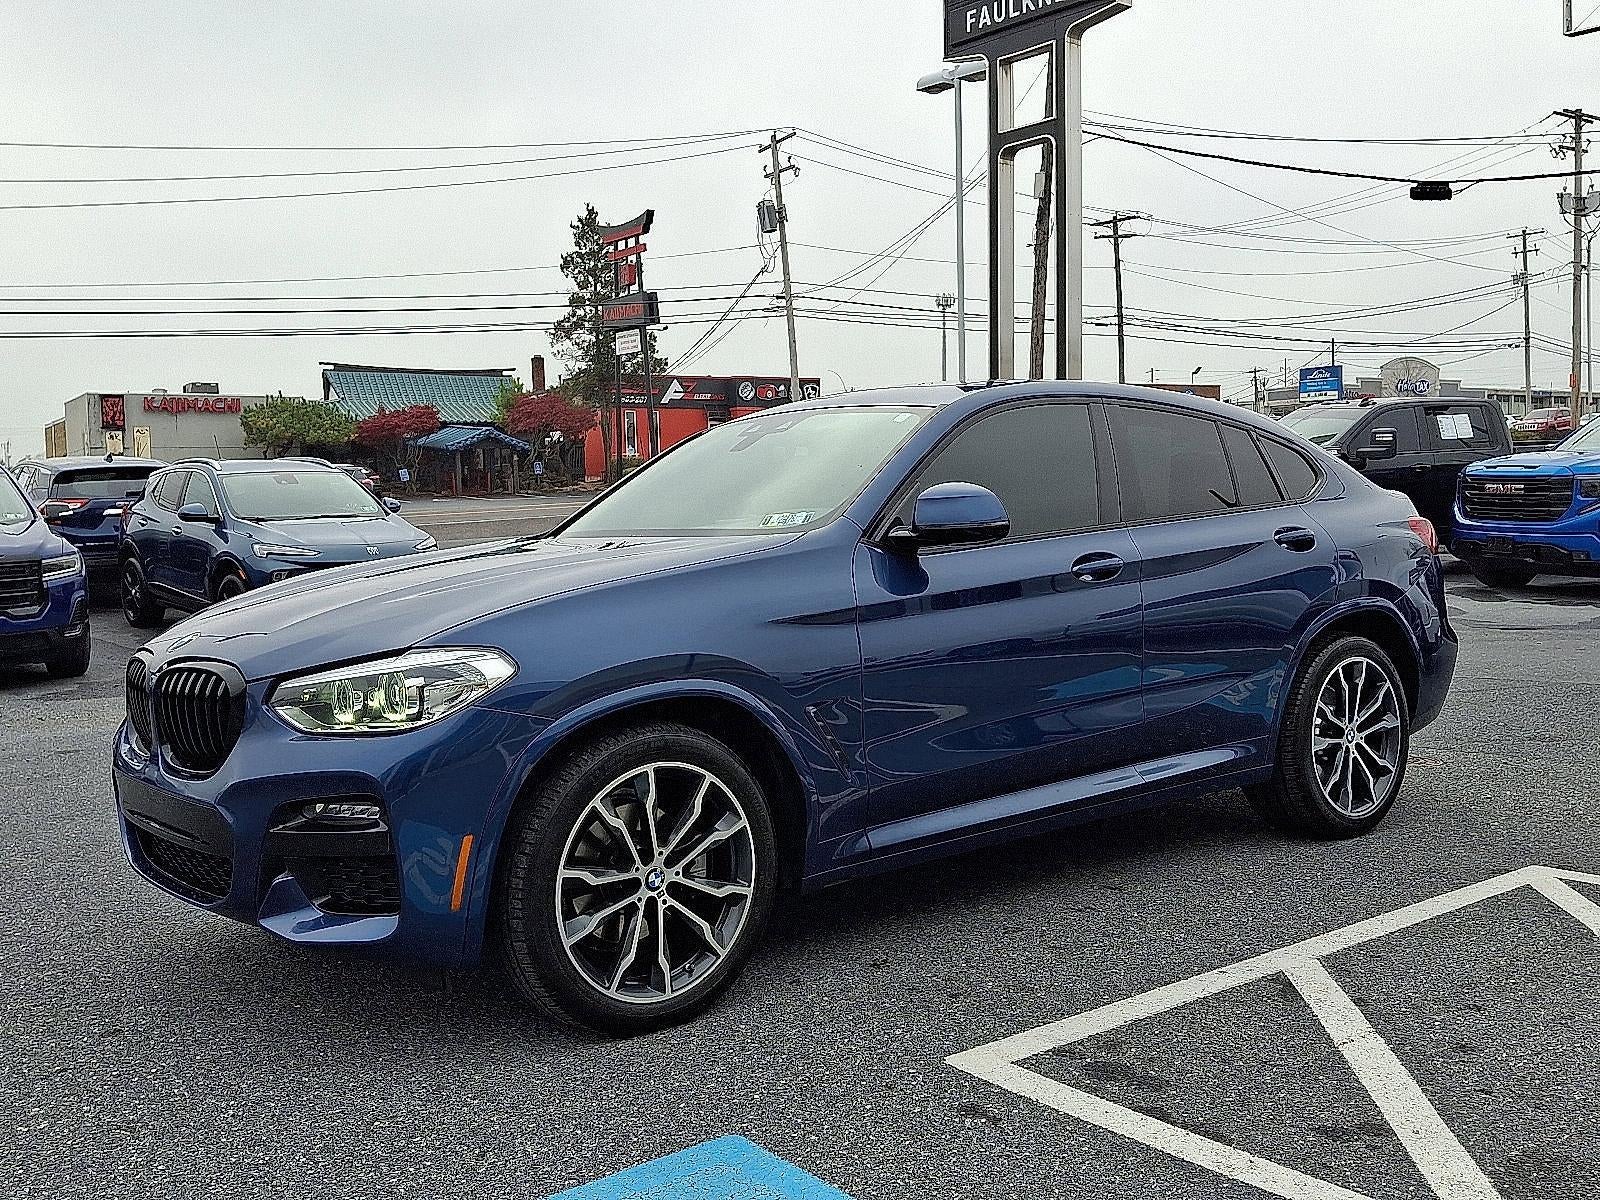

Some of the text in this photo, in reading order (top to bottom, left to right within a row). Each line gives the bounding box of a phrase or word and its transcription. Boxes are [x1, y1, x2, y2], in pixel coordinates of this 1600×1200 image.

[966, 0, 1064, 33] FAULK
[143, 396, 241, 413] KAJIMACHI
[1484, 484, 1525, 494] GMC
